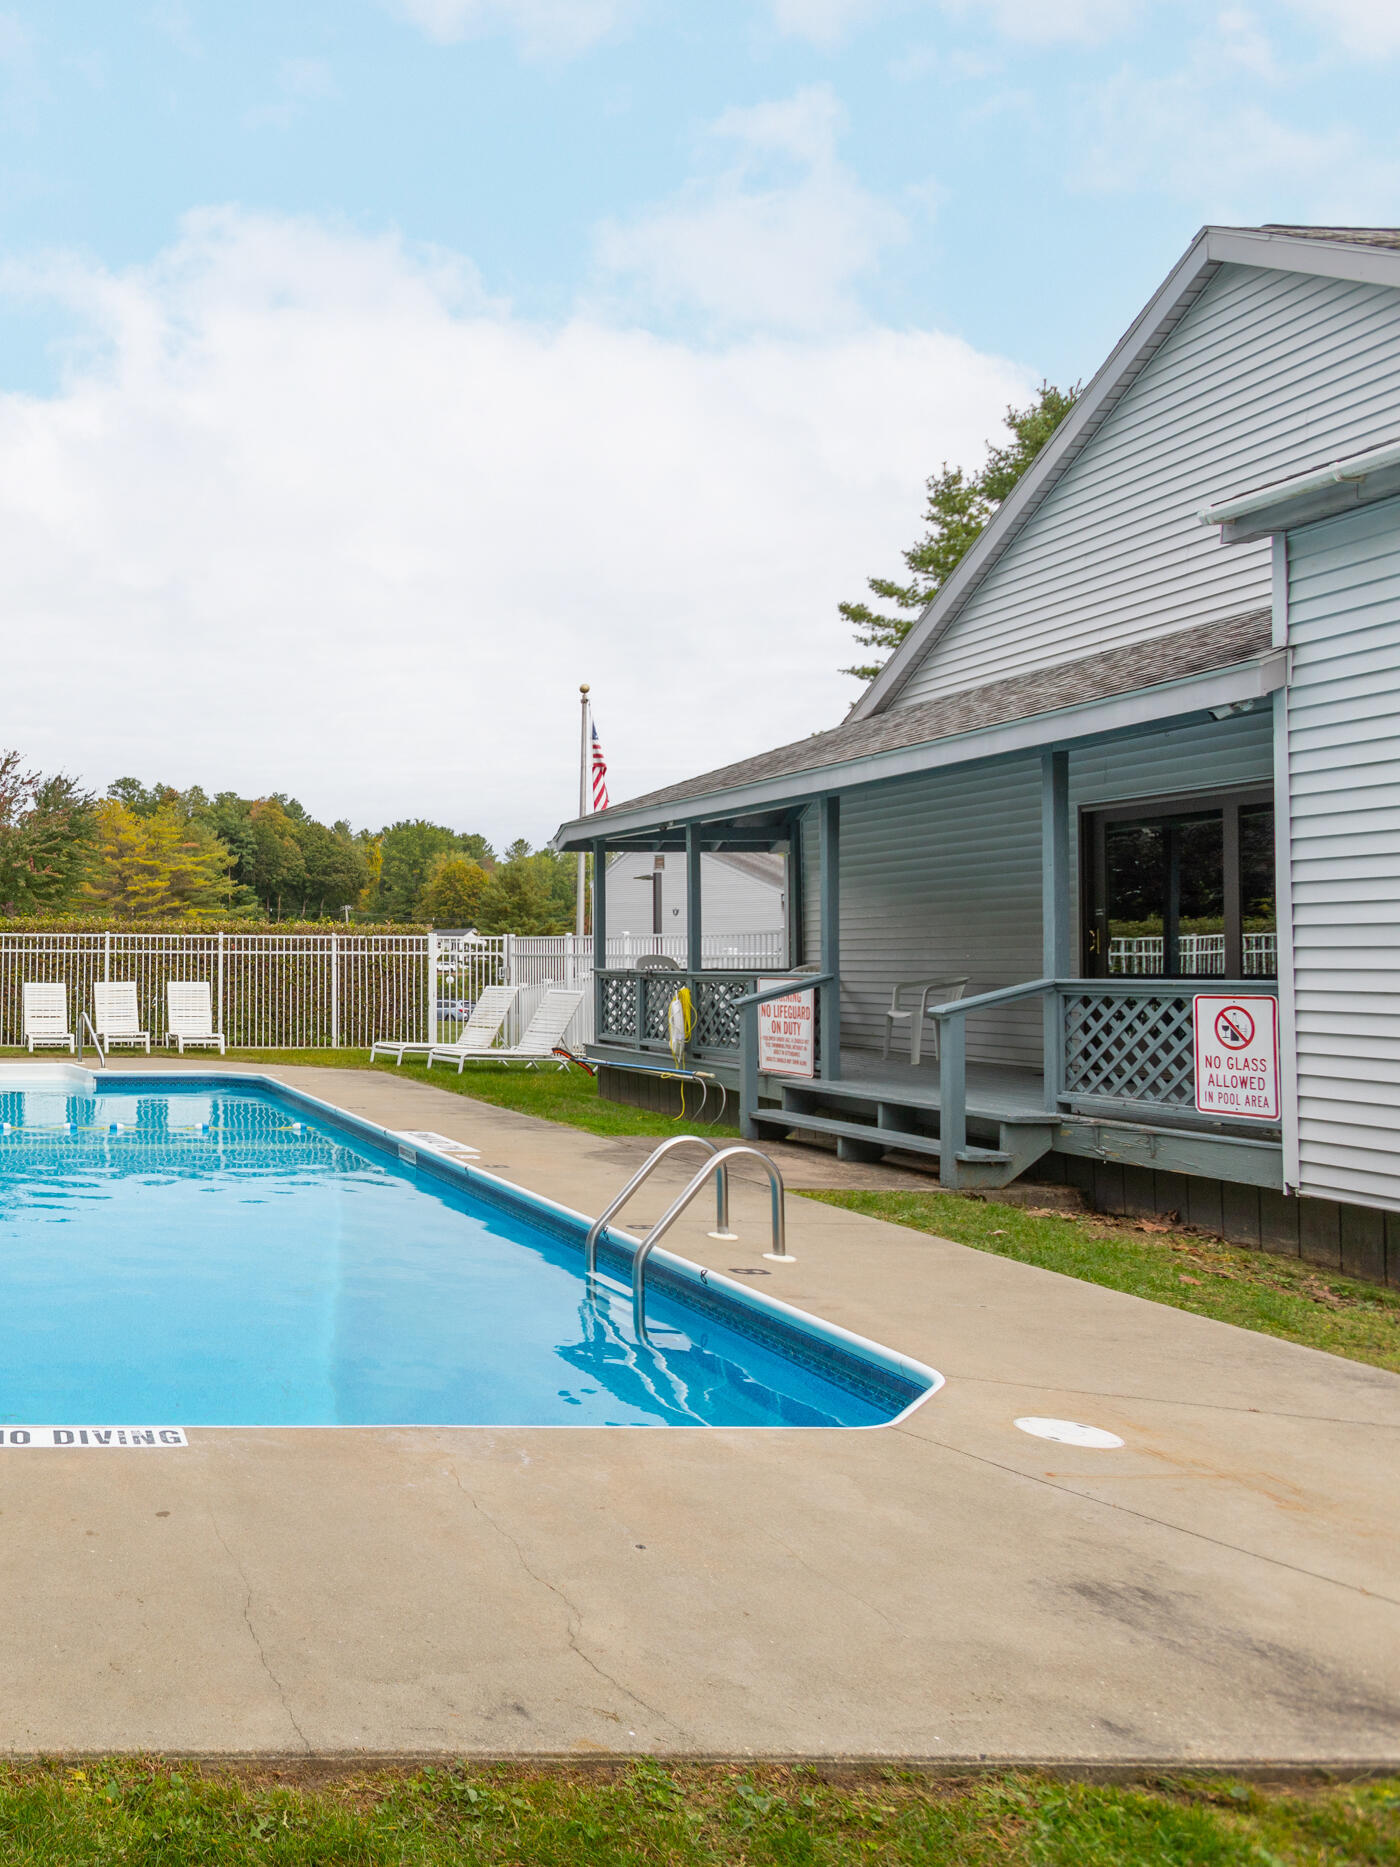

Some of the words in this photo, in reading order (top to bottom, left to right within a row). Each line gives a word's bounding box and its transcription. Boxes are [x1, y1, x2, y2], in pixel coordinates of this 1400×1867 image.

[761, 1004, 771, 1018] NO
[773, 1005, 811, 1020] LIFEGUARD
[771, 1020, 781, 1034] ON
[783, 1021, 802, 1036] DUTY
[1205, 1055, 1221, 1069] NO
[1227, 1056, 1267, 1072] GLASS
[1208, 1074, 1266, 1091] ALLOWED
[1204, 1091, 1214, 1103] IN
[1218, 1092, 1241, 1106] POOL
[1244, 1095, 1270, 1108] AREA
[53, 1429, 183, 1446] DIVING
